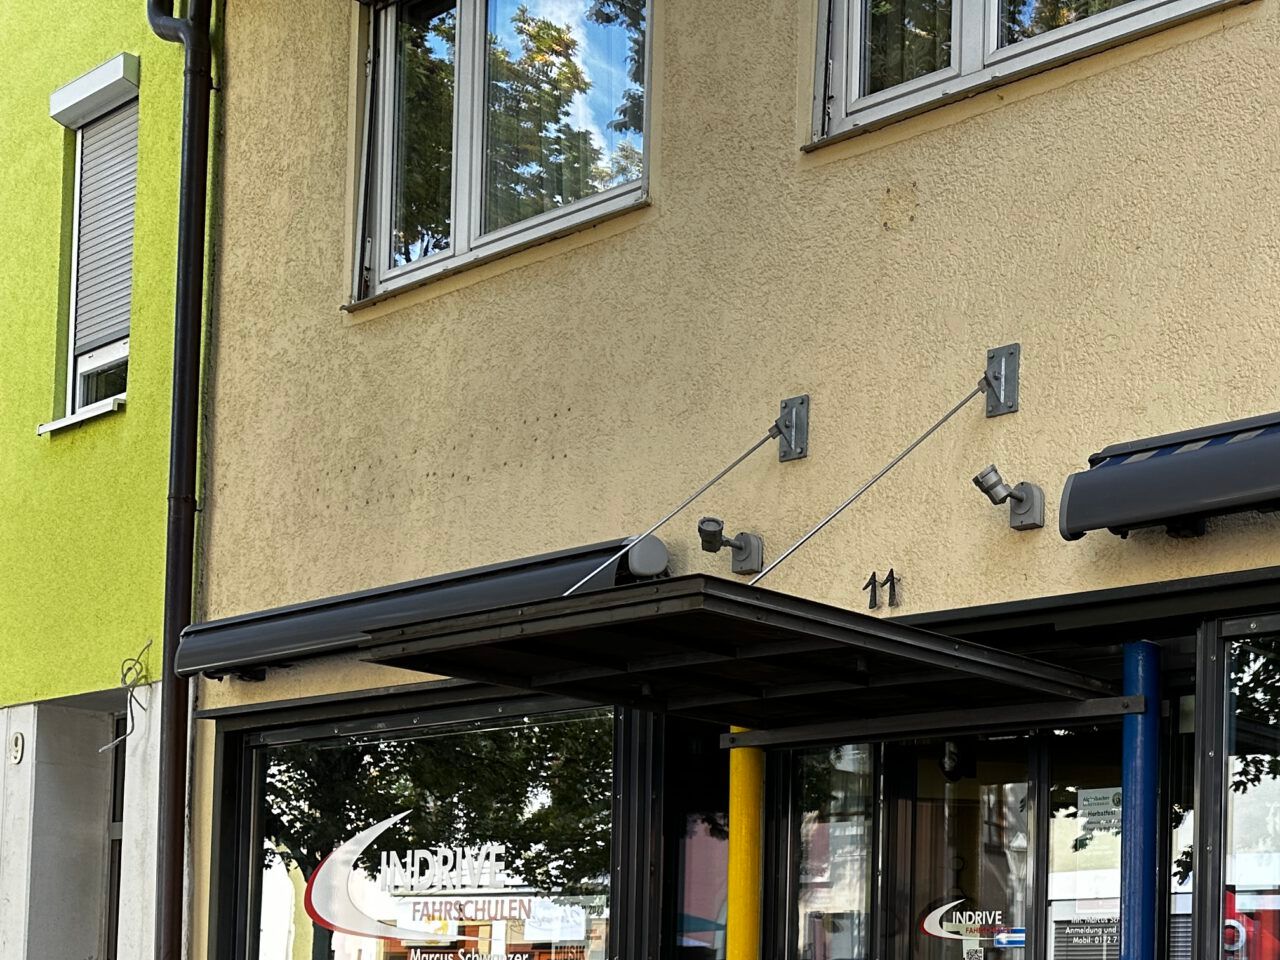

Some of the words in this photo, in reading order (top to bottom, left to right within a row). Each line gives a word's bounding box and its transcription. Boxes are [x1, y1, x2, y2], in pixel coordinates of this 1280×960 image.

[862, 568, 897, 609] 11
[11, 732, 24, 764] 9
[380, 845, 506, 893] INDRIVE
[412, 898, 532, 921] FAHRSCHULEN
[952, 911, 1002, 925] INDRIVE
[1065, 926, 1103, 935] Anmeldung
[1103, 926, 1117, 934] und
[1072, 936, 1093, 944] Mobil:
[1094, 936, 1111, 944] 0172
